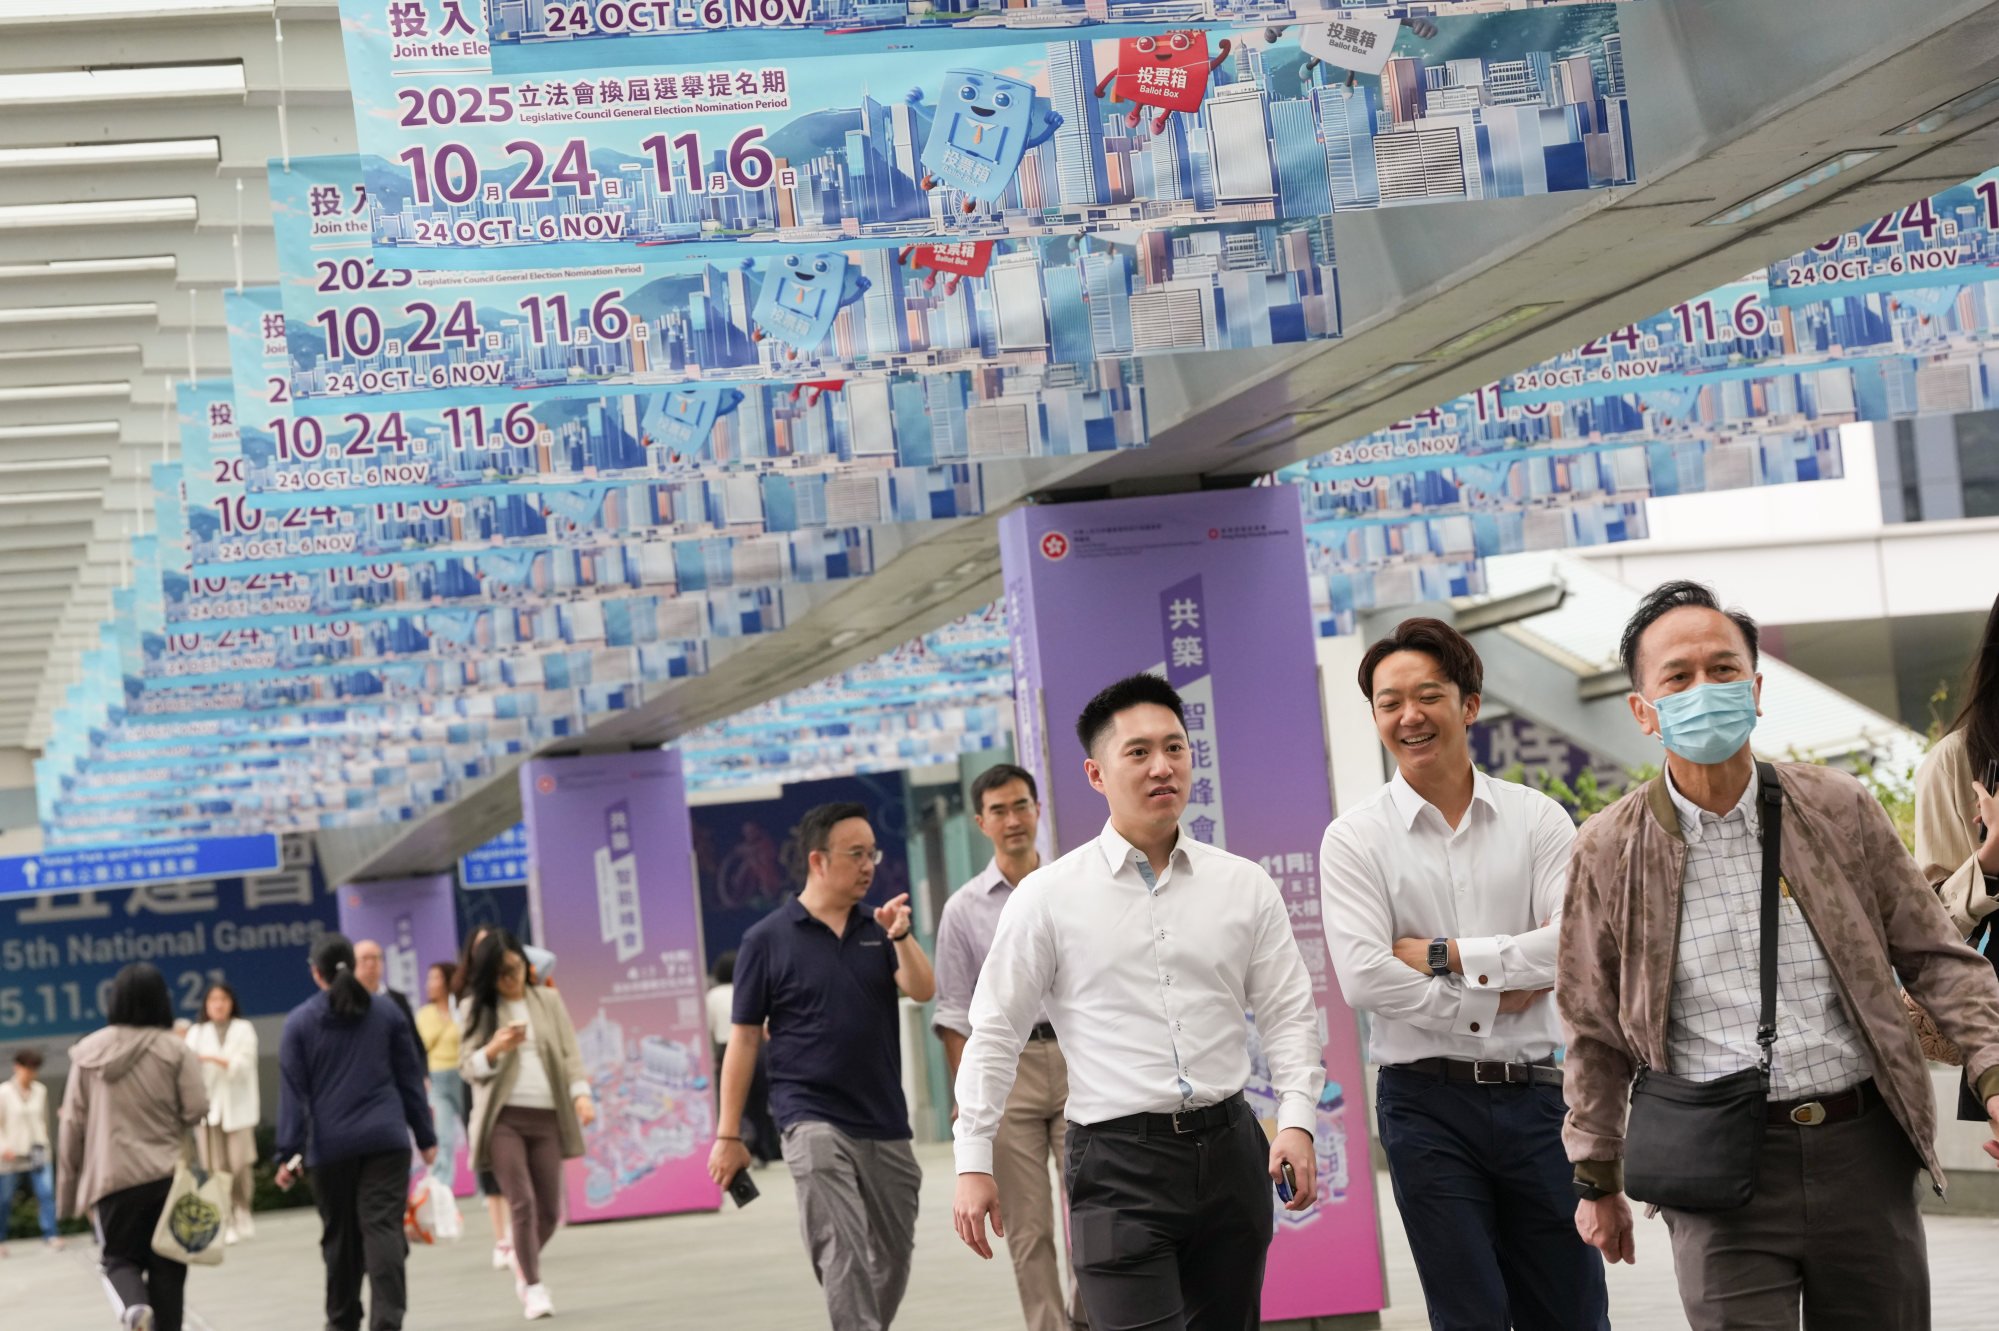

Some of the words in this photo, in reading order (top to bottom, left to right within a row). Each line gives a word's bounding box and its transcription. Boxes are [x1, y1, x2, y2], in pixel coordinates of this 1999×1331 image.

[389, 1, 490, 39] 投入
[547, 5, 589, 32] 24
[600, 0, 671, 30] OCT
[703, 0, 723, 24] 6
[732, 0, 812, 22] NOV
[1326, 22, 1378, 49] 投票箱
[1328, 39, 1351, 51] Ballot
[1351, 45, 1368, 56] Box
[393, 42, 428, 60] Join
[430, 41, 461, 58] the
[1136, 66, 1188, 90] 投票箱
[1139, 84, 1162, 96] Ballot
[1164, 89, 1180, 98] Box
[399, 86, 515, 128] 2025
[518, 70, 787, 108] 立法會換屆選舉提名期
[519, 111, 573, 123] Legislative
[574, 108, 612, 120] Council
[613, 107, 652, 119] General
[654, 104, 694, 116] Election
[695, 101, 754, 113] Nomination
[755, 98, 788, 110] Period
[312, 220, 343, 235] Join
[345, 219, 368, 233] the
[417, 221, 448, 242] 24
[456, 219, 513, 241] OCT
[539, 218, 555, 238] 6
[564, 214, 622, 238] NOV
[495, 273, 528, 282] General
[529, 271, 564, 280] Election
[564, 268, 613, 277] Nomination
[614, 265, 642, 274] Period
[1789, 267, 1816, 285] 24
[1823, 259, 1869, 282] OCT
[1889, 254, 1903, 274] 6
[1911, 249, 1960, 270] NOV
[328, 376, 354, 392] 24
[361, 370, 410, 389] OCT
[432, 368, 444, 385] 6
[452, 363, 502, 382] NOV
[1516, 375, 1538, 390] 24
[1543, 368, 1583, 387] OCT
[1601, 365, 1612, 381] 6
[1618, 360, 1660, 379] NOV
[1421, 438, 1458, 453] NOV
[279, 473, 300, 488] 24
[307, 470, 347, 486] OCT
[367, 469, 377, 484] 6
[384, 466, 427, 482] NOV
[248, 541, 283, 557] OCT
[316, 537, 354, 551] NOV
[1168, 598, 1205, 668] 共築
[66, 923, 206, 964] National
[213, 917, 327, 954] Games
